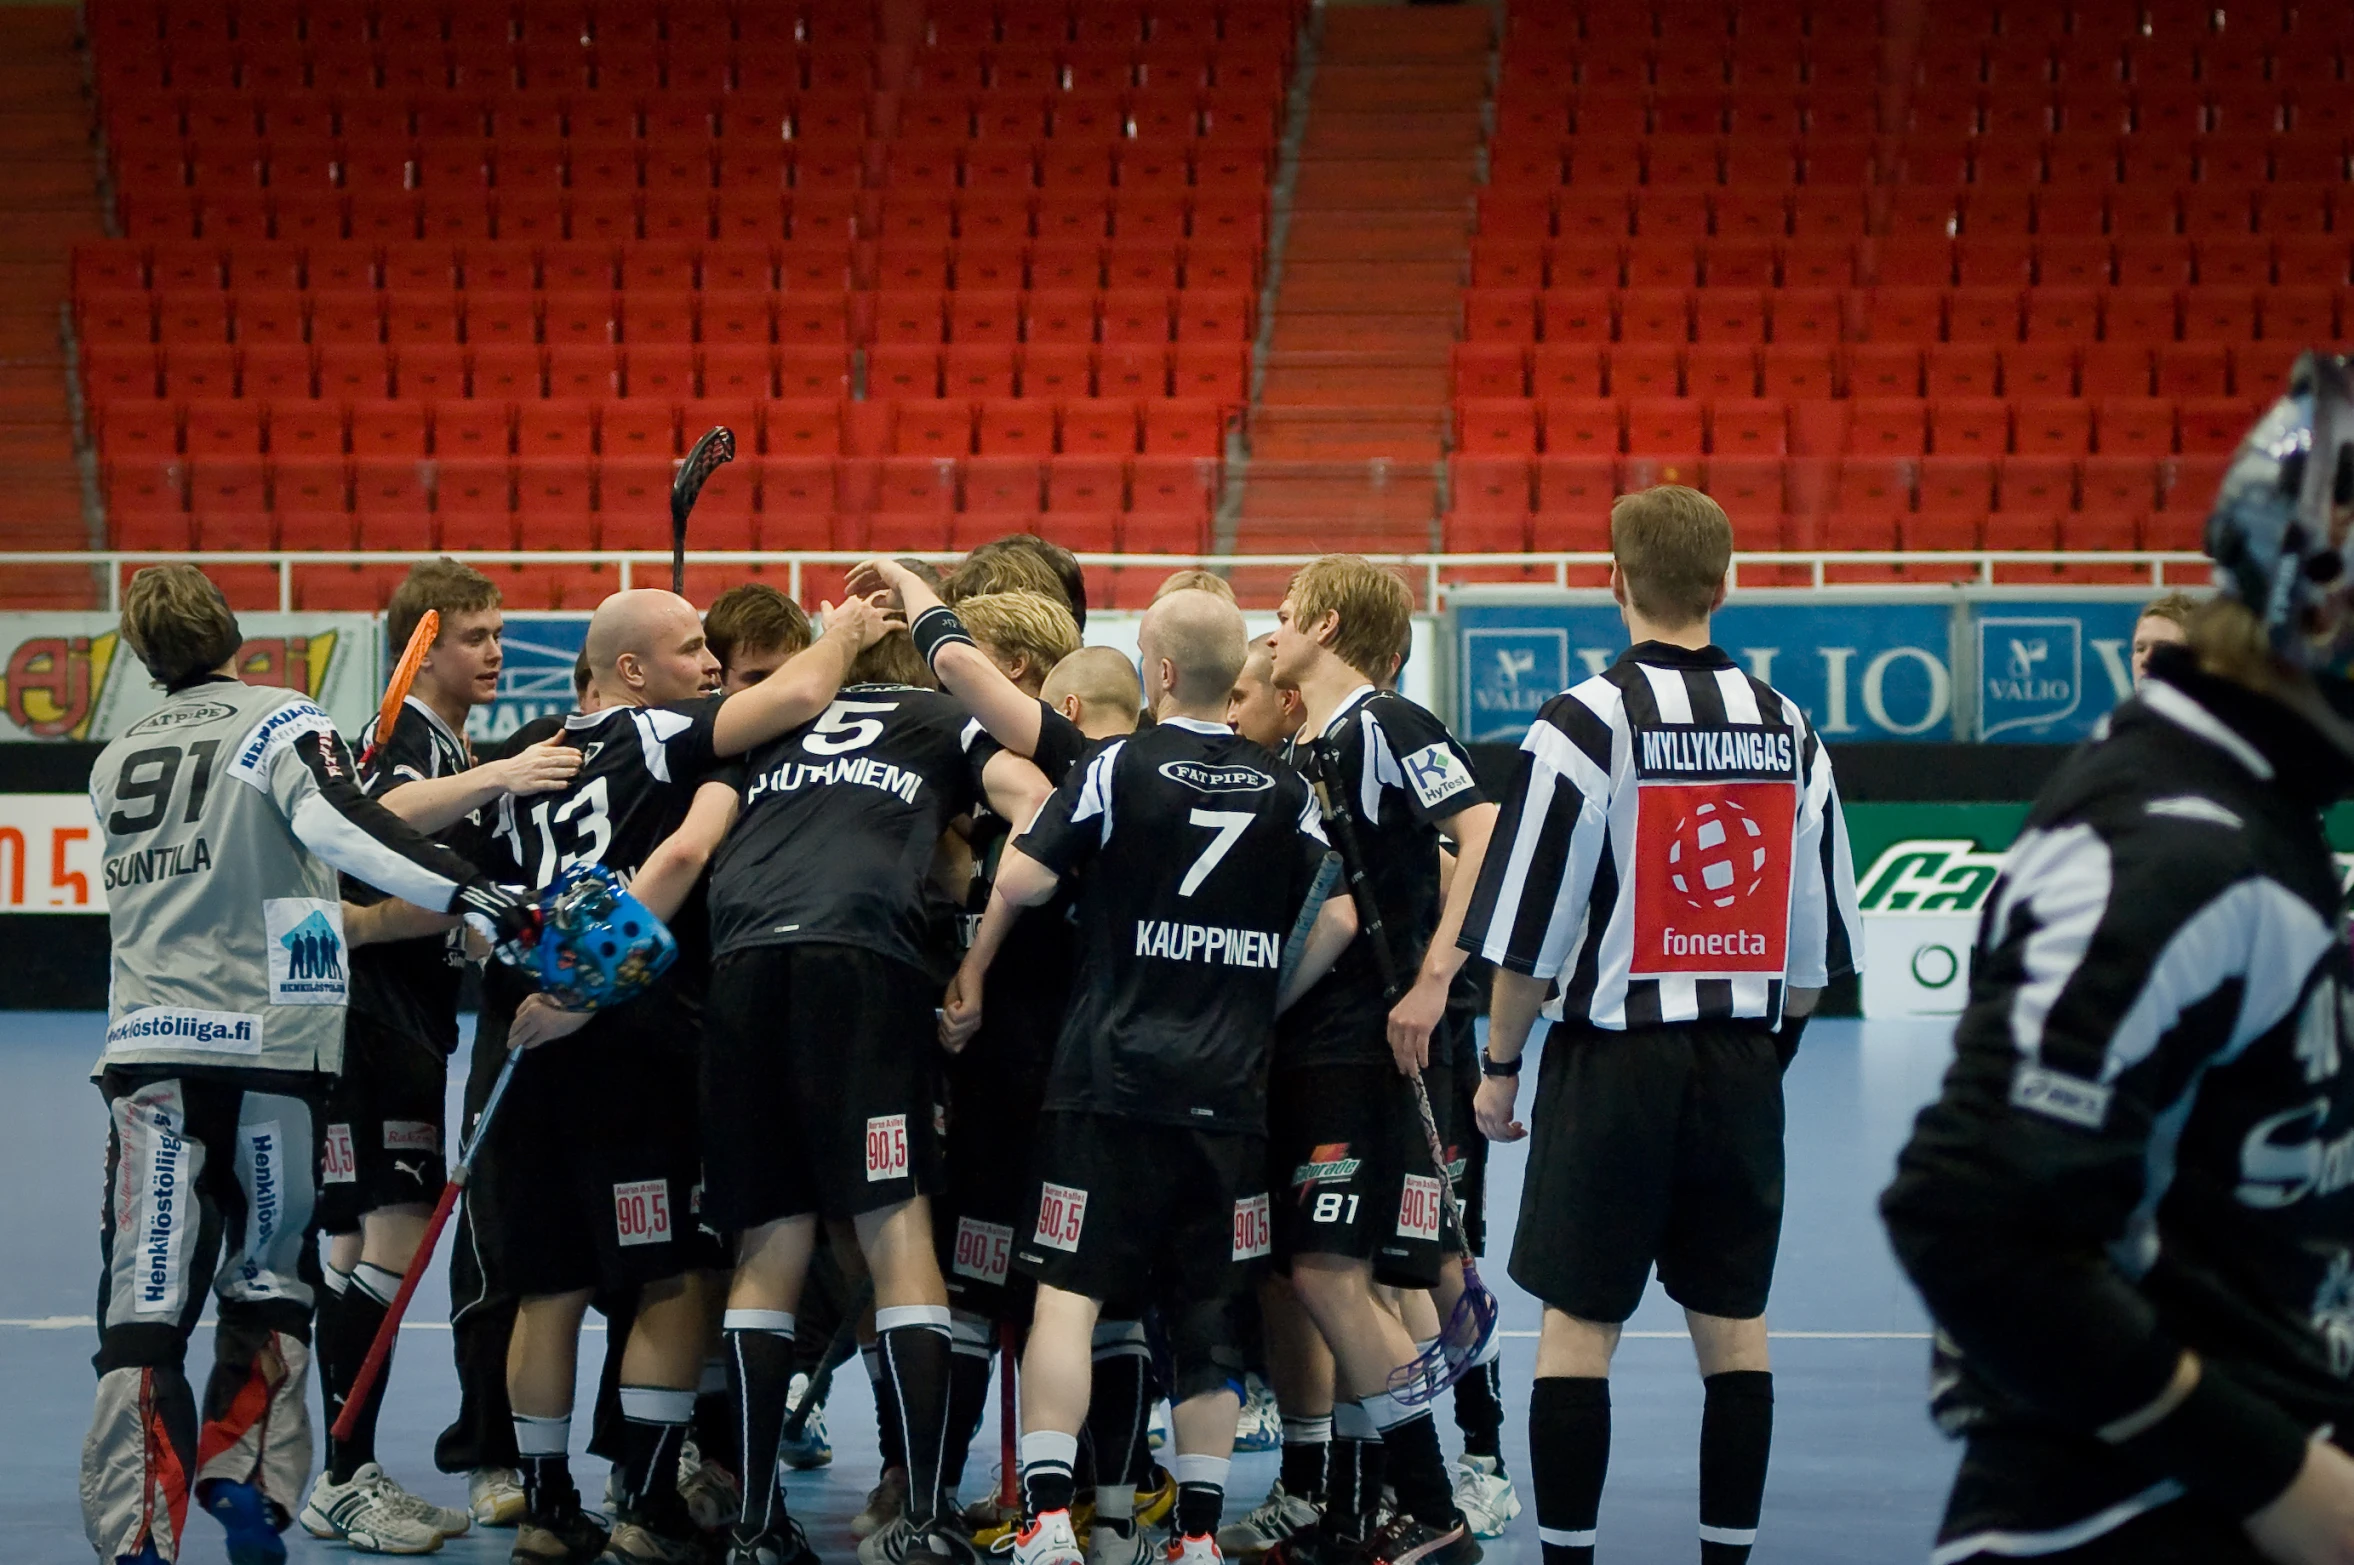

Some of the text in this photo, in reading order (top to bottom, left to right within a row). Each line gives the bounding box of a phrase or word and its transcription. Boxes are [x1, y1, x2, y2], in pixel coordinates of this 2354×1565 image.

[1989, 677, 2070, 701] VALIO
[802, 700, 900, 755] 5
[1642, 731, 1792, 772] MYLLYKANGAS
[109, 739, 221, 836] 91
[1425, 774, 1467, 802] HyTest
[104, 838, 212, 891] SUNTILA
[1178, 808, 1257, 897] 7
[1135, 920, 1280, 969] KAUPPINEN
[1663, 927, 1766, 956] fonecta
[868, 1129, 905, 1175] 90,5
[617, 1194, 668, 1240] 90,5
[1039, 1196, 1082, 1245] 90,5
[1235, 1207, 1268, 1253] 90,5
[1313, 1193, 1359, 1224] 81
[1401, 1188, 1439, 1235] 90,5
[957, 1230, 1009, 1276] 90,5
